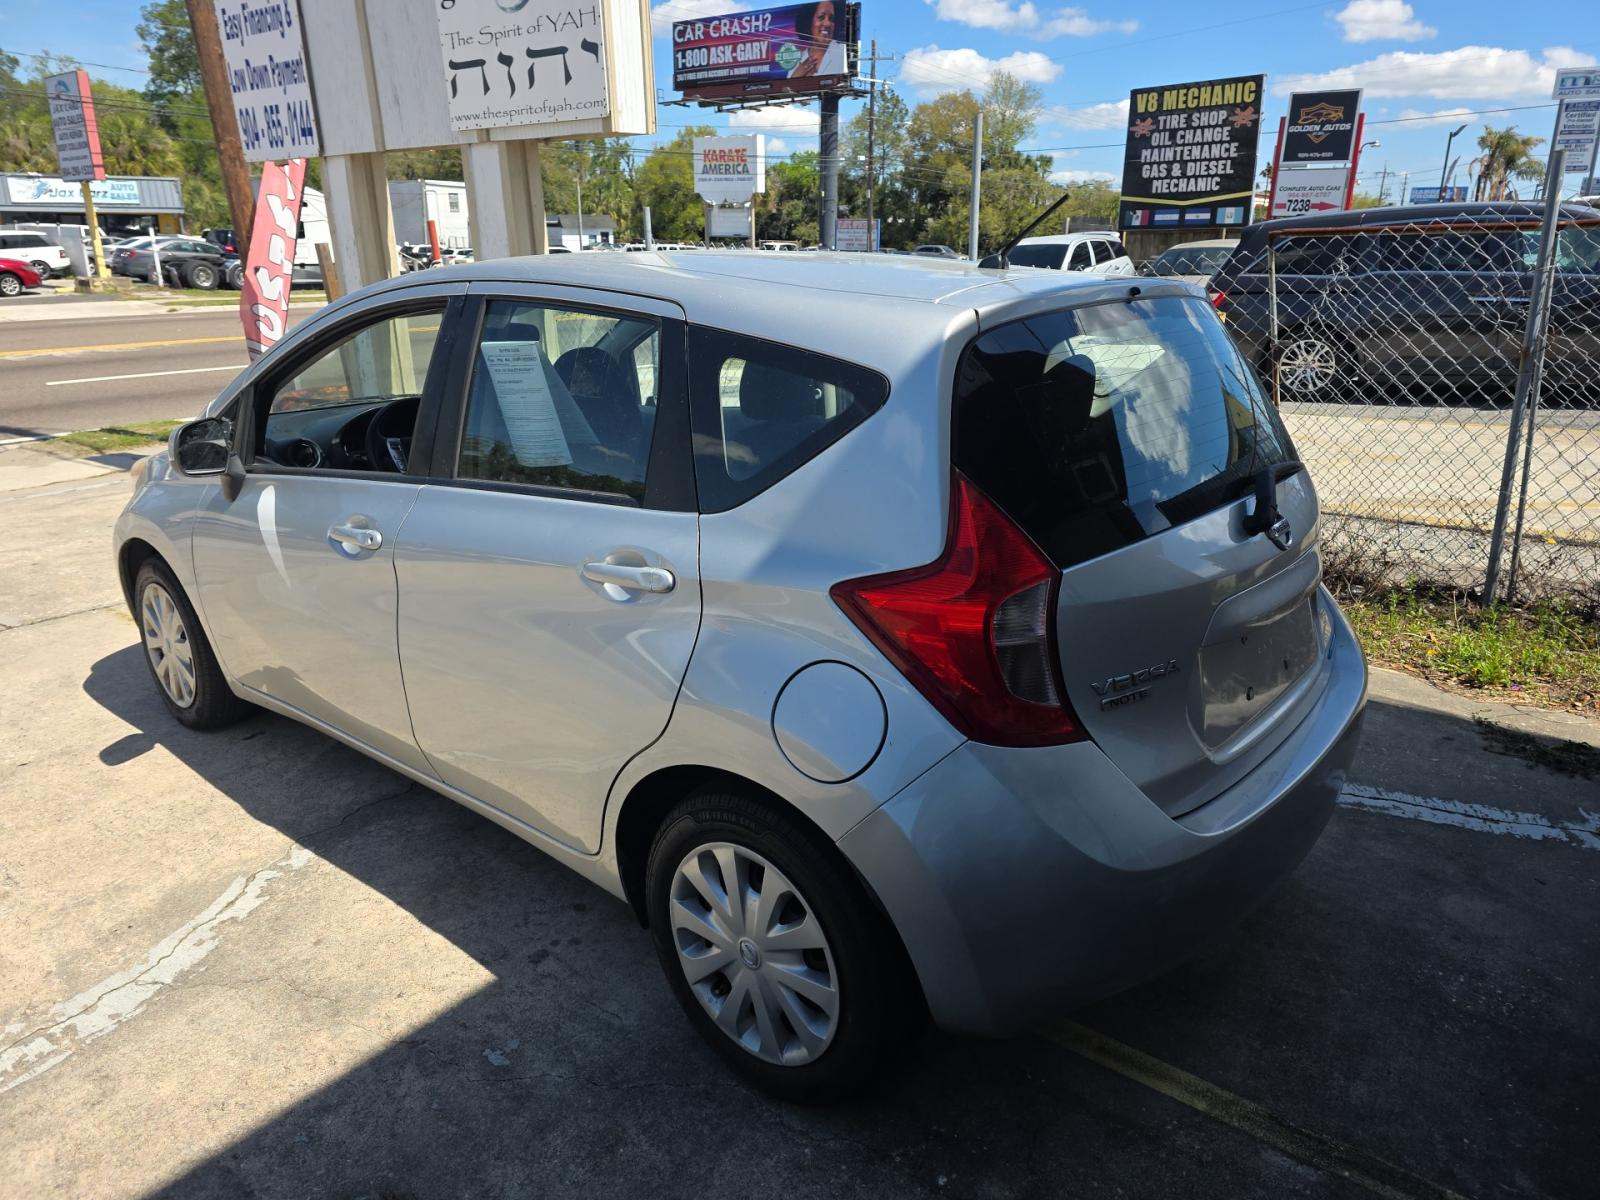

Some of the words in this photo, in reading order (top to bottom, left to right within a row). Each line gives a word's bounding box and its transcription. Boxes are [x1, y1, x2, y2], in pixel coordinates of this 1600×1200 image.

[221, 8, 244, 47] Easy
[241, 3, 285, 39] Financing
[445, 32, 474, 49] The
[478, 23, 524, 47] Spirit
[527, 15, 544, 34] of
[546, 5, 597, 33] YAH
[674, 24, 705, 43] CAR
[709, 13, 772, 38] CRASH?
[676, 48, 708, 69] 1-800
[709, 41, 769, 65] ASK-GARY
[228, 62, 248, 93] Low
[244, 58, 272, 90] Down
[268, 52, 306, 96] Payment
[1136, 92, 1158, 113] V8
[1162, 81, 1257, 111] MECHANIC
[453, 98, 606, 123] www.thespiritofyah.com
[1158, 113, 1188, 130] TIRE
[1191, 110, 1227, 127] SHOP
[1151, 131, 1172, 147] OIL
[1176, 127, 1231, 145] CHANGE
[1288, 124, 1321, 133] GOLDEN
[1323, 123, 1352, 132] AUTOS
[703, 148, 748, 164] KARATE
[1140, 142, 1239, 163] MAINTENANCE
[702, 163, 750, 175] AMERICA
[1142, 163, 1168, 178] GAS
[1171, 163, 1182, 177] &
[1186, 159, 1234, 176] DIESEL
[1152, 177, 1221, 194] MECHANIC
[1287, 199, 1311, 212] 7238
